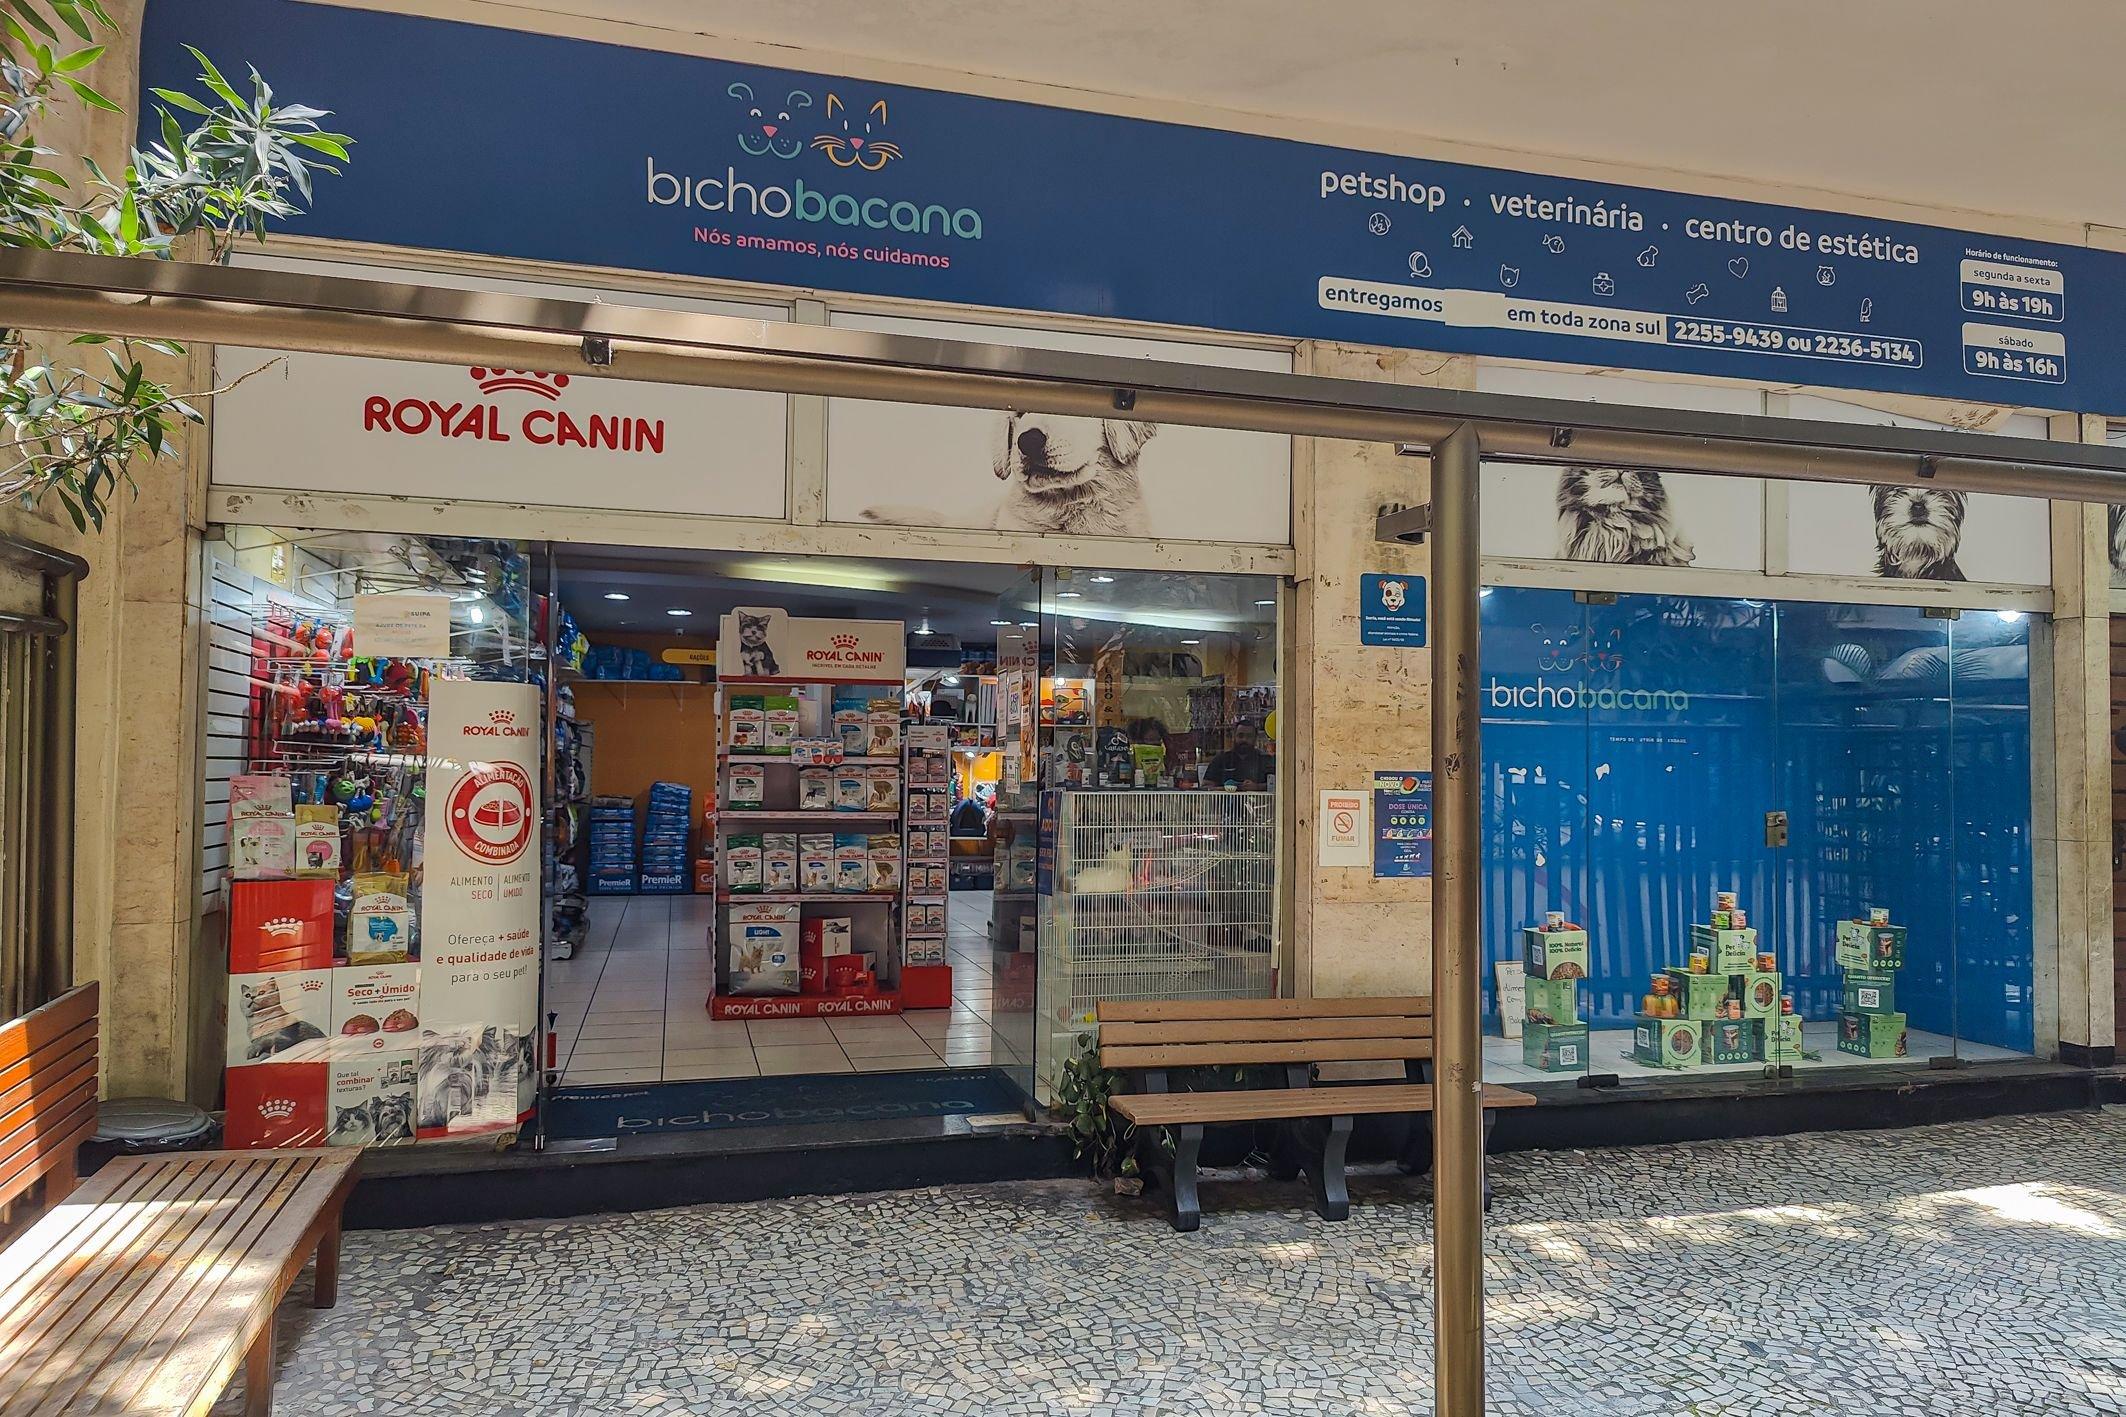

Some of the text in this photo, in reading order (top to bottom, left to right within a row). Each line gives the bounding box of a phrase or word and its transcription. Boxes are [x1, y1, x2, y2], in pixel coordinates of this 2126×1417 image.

[646, 155, 983, 240] bichobacana
[1320, 169, 1919, 265] petshop veterinária centro de estética
[694, 226, 950, 269] Nós amamos, nós cuidamos
[1965, 248, 2058, 268] Horário de funcionamento:
[1974, 270, 2014, 281] segunda
[2024, 275, 2051, 286] sexta
[1325, 285, 1661, 336] entregamos em toda zona sul
[1972, 290, 2053, 315] 9h às 19h
[1673, 320, 1915, 364] 2255-9439 ou 2236-5134
[1998, 336, 2034, 348] sábado
[1975, 351, 2058, 376] 9h às 16h
[364, 395, 665, 454] ROYAL CANIN
[806, 650, 882, 662] ROYAL CANIN
[1491, 677, 1689, 710] bichobacana
[463, 726, 500, 736] ROYAL
[474, 841, 519, 856] COMBINADA
[450, 876, 493, 886] ALIMENTO
[472, 890, 493, 900] SECO
[448, 934, 495, 946] Ofereça
[507, 929, 529, 941] saúde
[436, 945, 534, 966] e qualidade de vida
[451, 973, 479, 985] para
[483, 972, 490, 980] o
[493, 970, 511, 980] seu
[348, 988, 373, 997] Seco
[382, 983, 415, 994] Úmido
[724, 1003, 800, 1015] ROYAL CANIN
[818, 1000, 891, 1012] ROYAL CANIN
[336, 1077, 374, 1086] combinar
